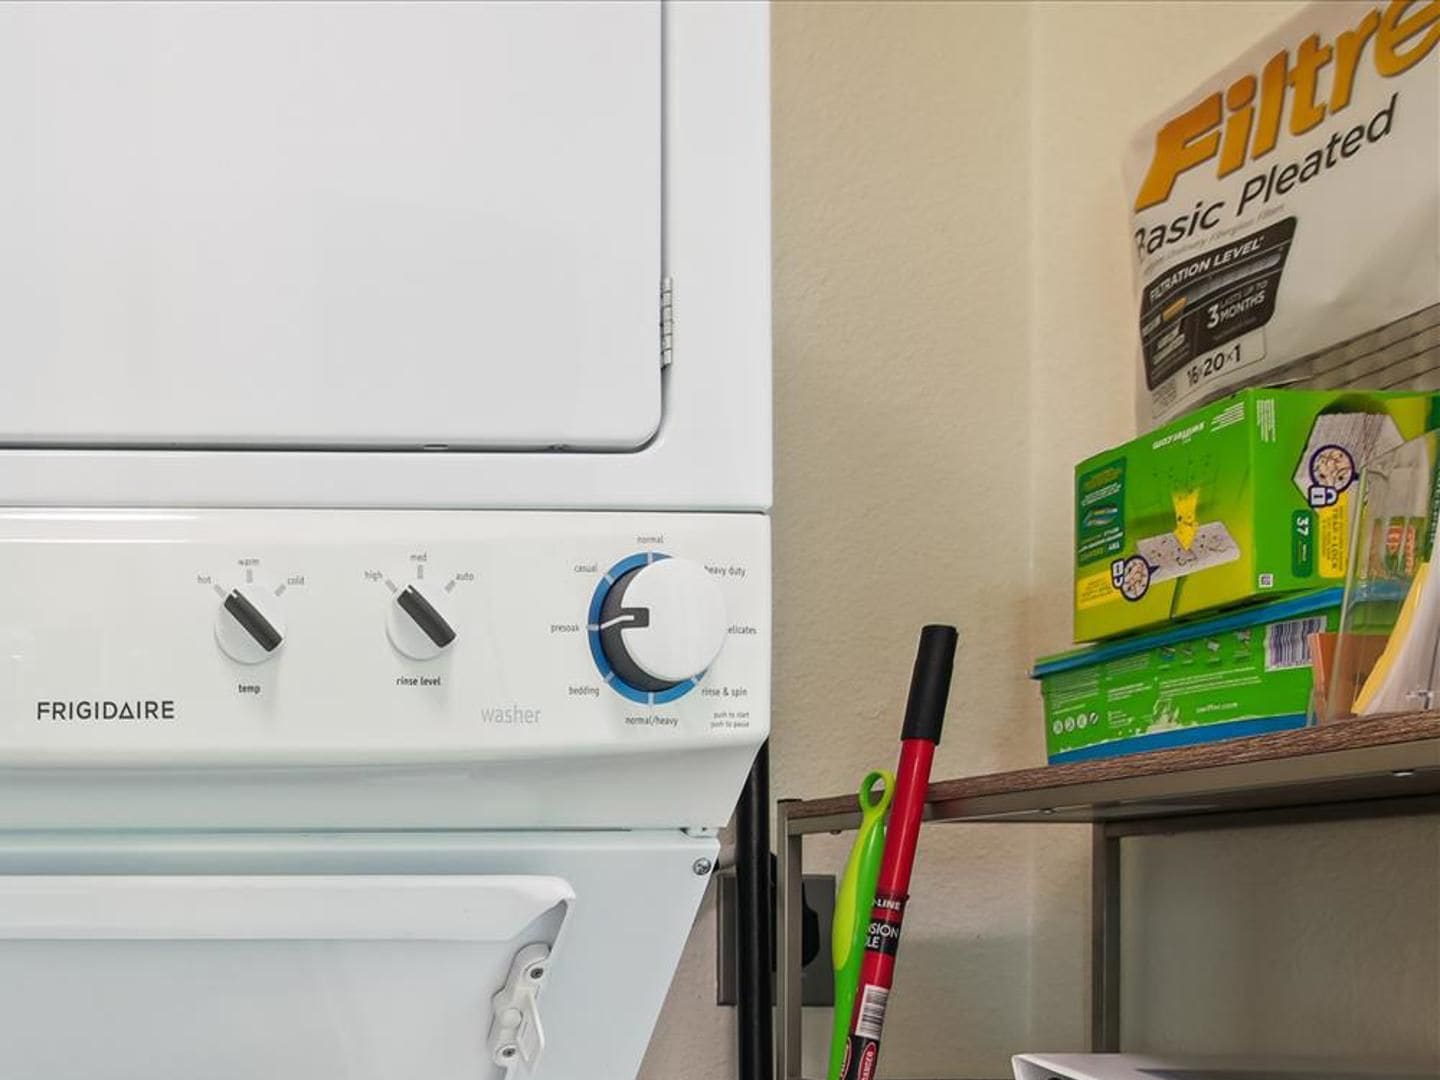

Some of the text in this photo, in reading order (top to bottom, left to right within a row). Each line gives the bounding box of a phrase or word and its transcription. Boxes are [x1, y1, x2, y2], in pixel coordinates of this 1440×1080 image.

[1236, 92, 1399, 217] Pleated
[1150, 256, 1211, 304] FILTRATION
[1207, 290, 1265, 329] 3 MONTHS
[1296, 516, 1310, 536] 37
[636, 534, 665, 545] normal
[237, 558, 260, 567] warm
[409, 551, 428, 562] med
[573, 562, 598, 573] casual
[728, 565, 747, 577] duty
[197, 575, 212, 585] hot
[287, 575, 305, 586] cold
[364, 569, 383, 581] high
[455, 572, 475, 582] auto
[550, 622, 580, 634] presoak
[396, 676, 442, 687] rinse level
[237, 684, 260, 695] temp
[568, 686, 600, 698] bedding
[701, 686, 748, 699] rinse & spin
[36, 700, 176, 720] FRIGIDAIRE
[480, 704, 542, 724] washer
[625, 714, 679, 728] normal/heavy
